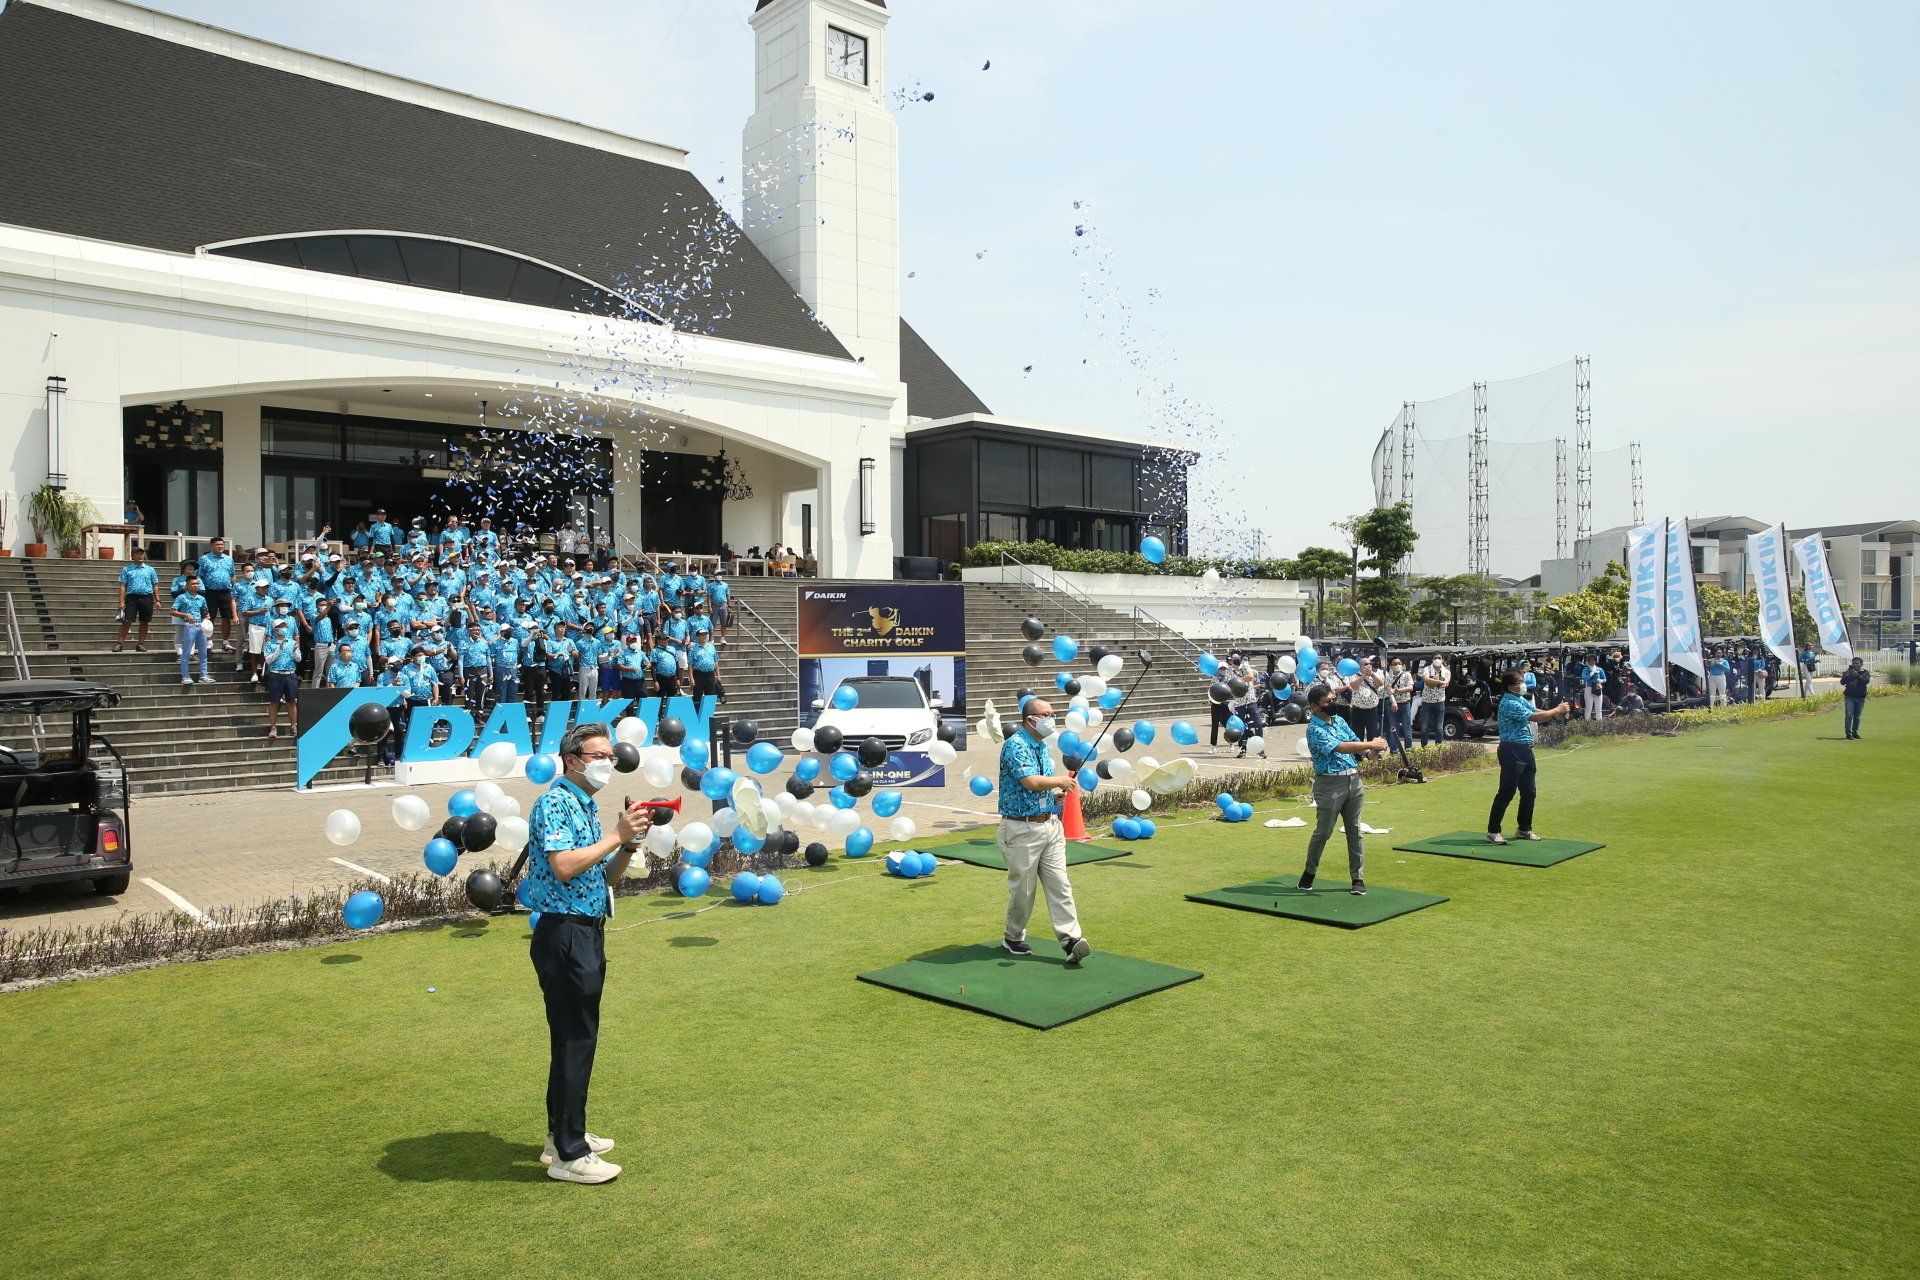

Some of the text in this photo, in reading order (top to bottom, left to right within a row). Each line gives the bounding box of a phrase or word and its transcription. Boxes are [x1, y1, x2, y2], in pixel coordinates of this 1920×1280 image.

[831, 627, 934, 637] THE 2nd DAIKIN
[843, 638, 924, 647] CHARITY GOLF
